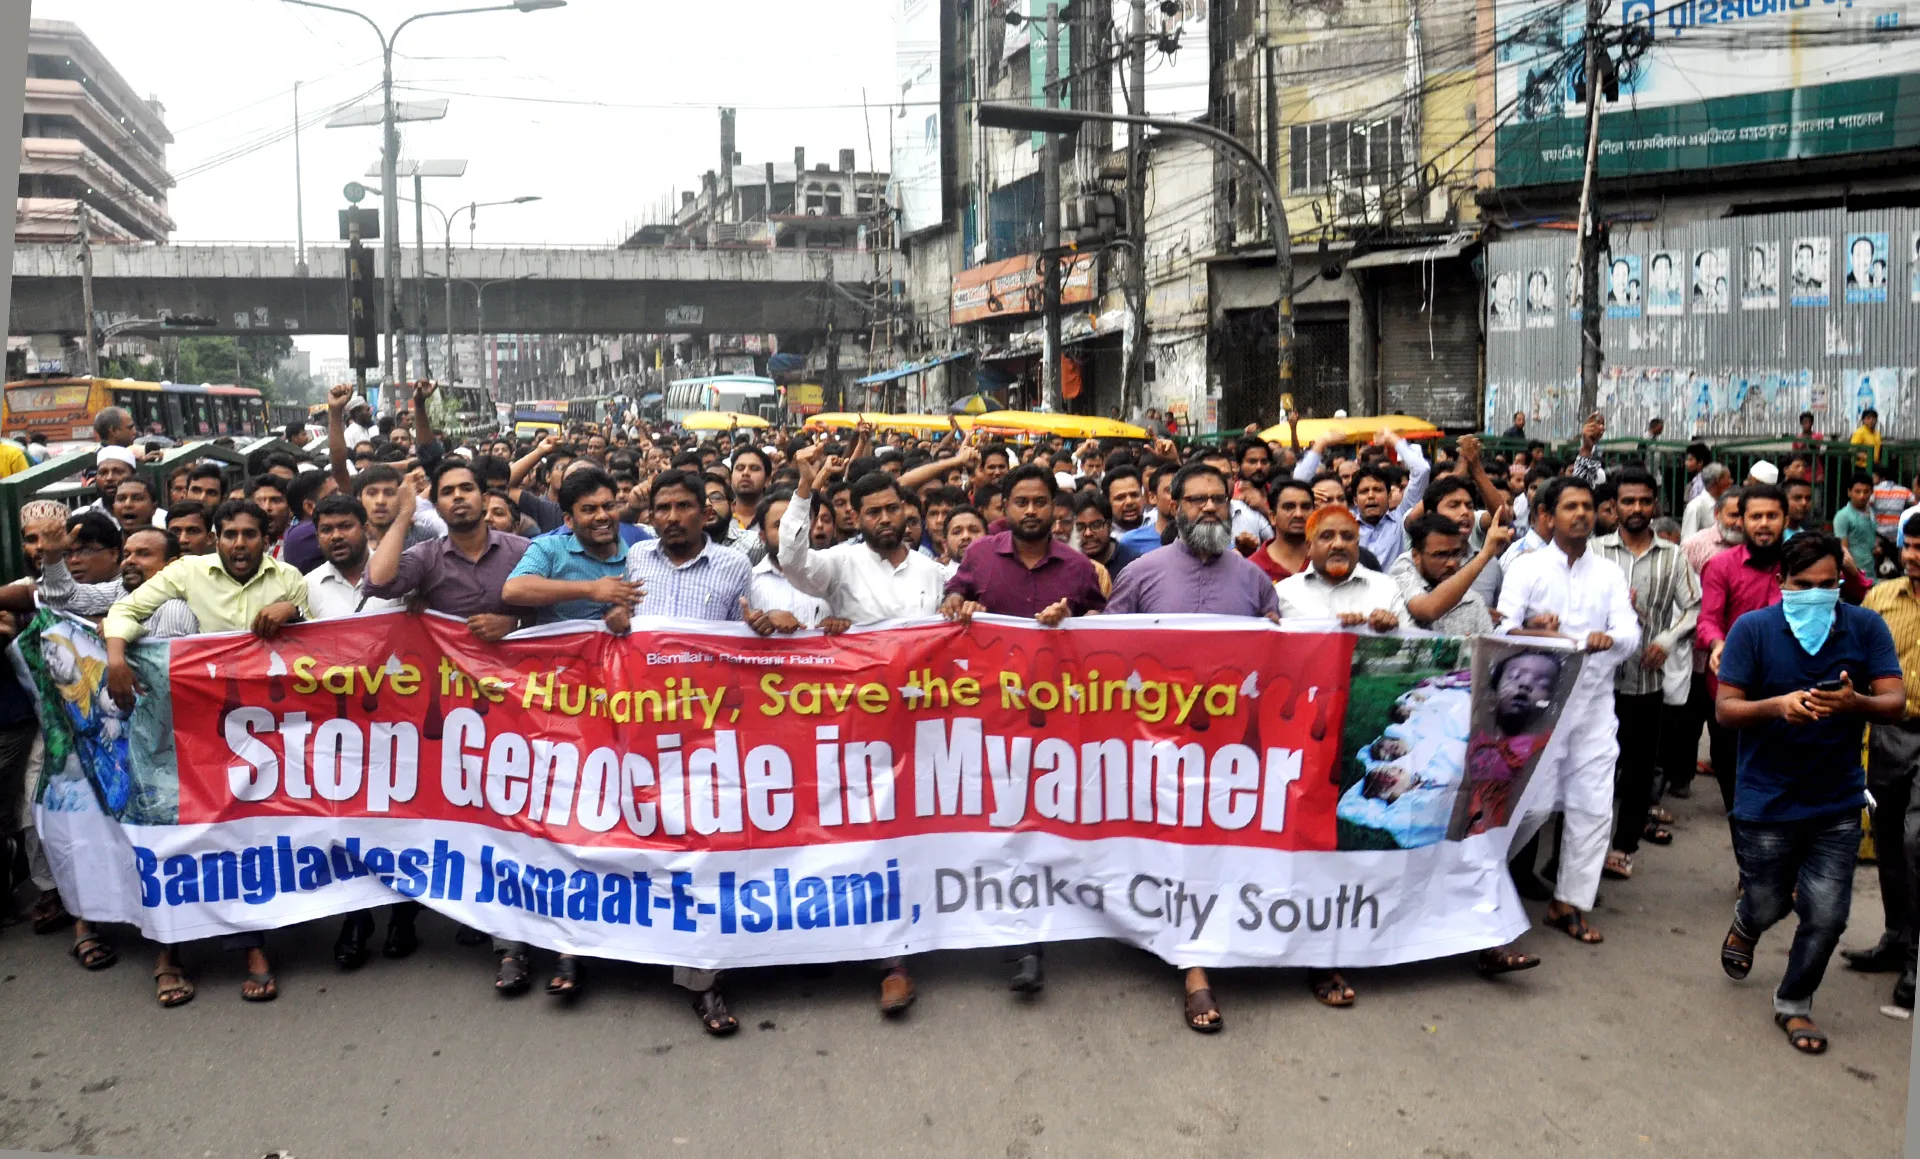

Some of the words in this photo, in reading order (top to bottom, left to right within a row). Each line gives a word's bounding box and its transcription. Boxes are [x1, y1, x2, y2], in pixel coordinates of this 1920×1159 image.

[293, 655, 421, 696] Save
[439, 655, 506, 703] the
[524, 671, 739, 729] Humanity,
[758, 672, 889, 716] Save
[905, 668, 981, 709] the
[1000, 669, 1237, 725] Rohingya
[789, 655, 835, 665] Rahim
[225, 706, 419, 812] Stop
[440, 707, 794, 837] Genocide
[815, 725, 895, 827] in
[914, 717, 1303, 834] Myanmer
[135, 836, 463, 908] Bangladesh
[935, 865, 1103, 914] Dhaka
[1128, 873, 1219, 940] City
[1237, 883, 1379, 933] South
